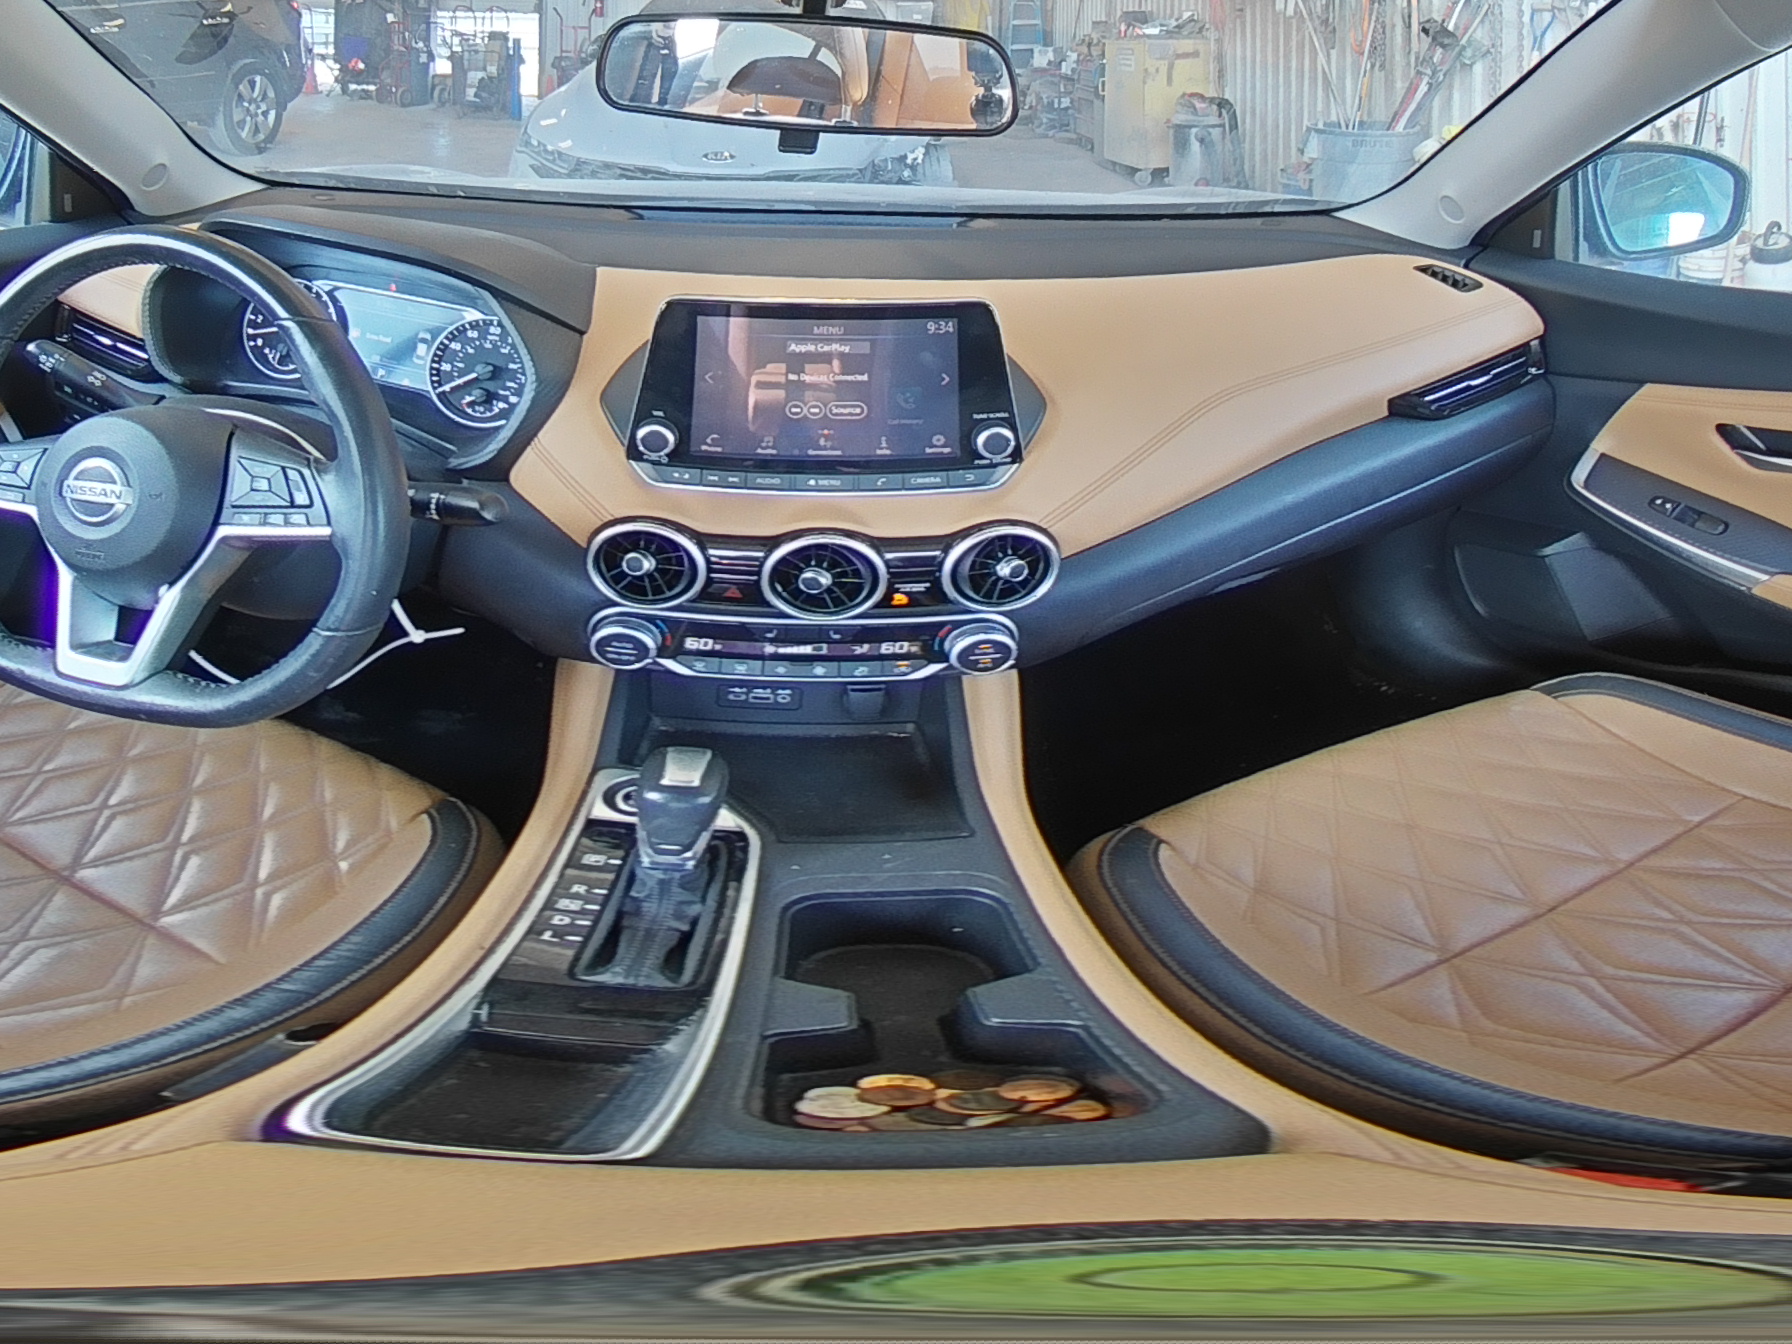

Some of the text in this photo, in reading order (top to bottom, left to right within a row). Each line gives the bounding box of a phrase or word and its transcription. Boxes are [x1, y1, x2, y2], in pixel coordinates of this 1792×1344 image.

[707, 152, 730, 160] KIA
[812, 325, 845, 336] MENU
[926, 321, 955, 335] 9:34
[789, 343, 850, 353] Apple CarPlay
[831, 405, 862, 415] Source
[64, 483, 123, 500] NISSAN
[569, 884, 589, 895] R
[549, 915, 572, 926] D
